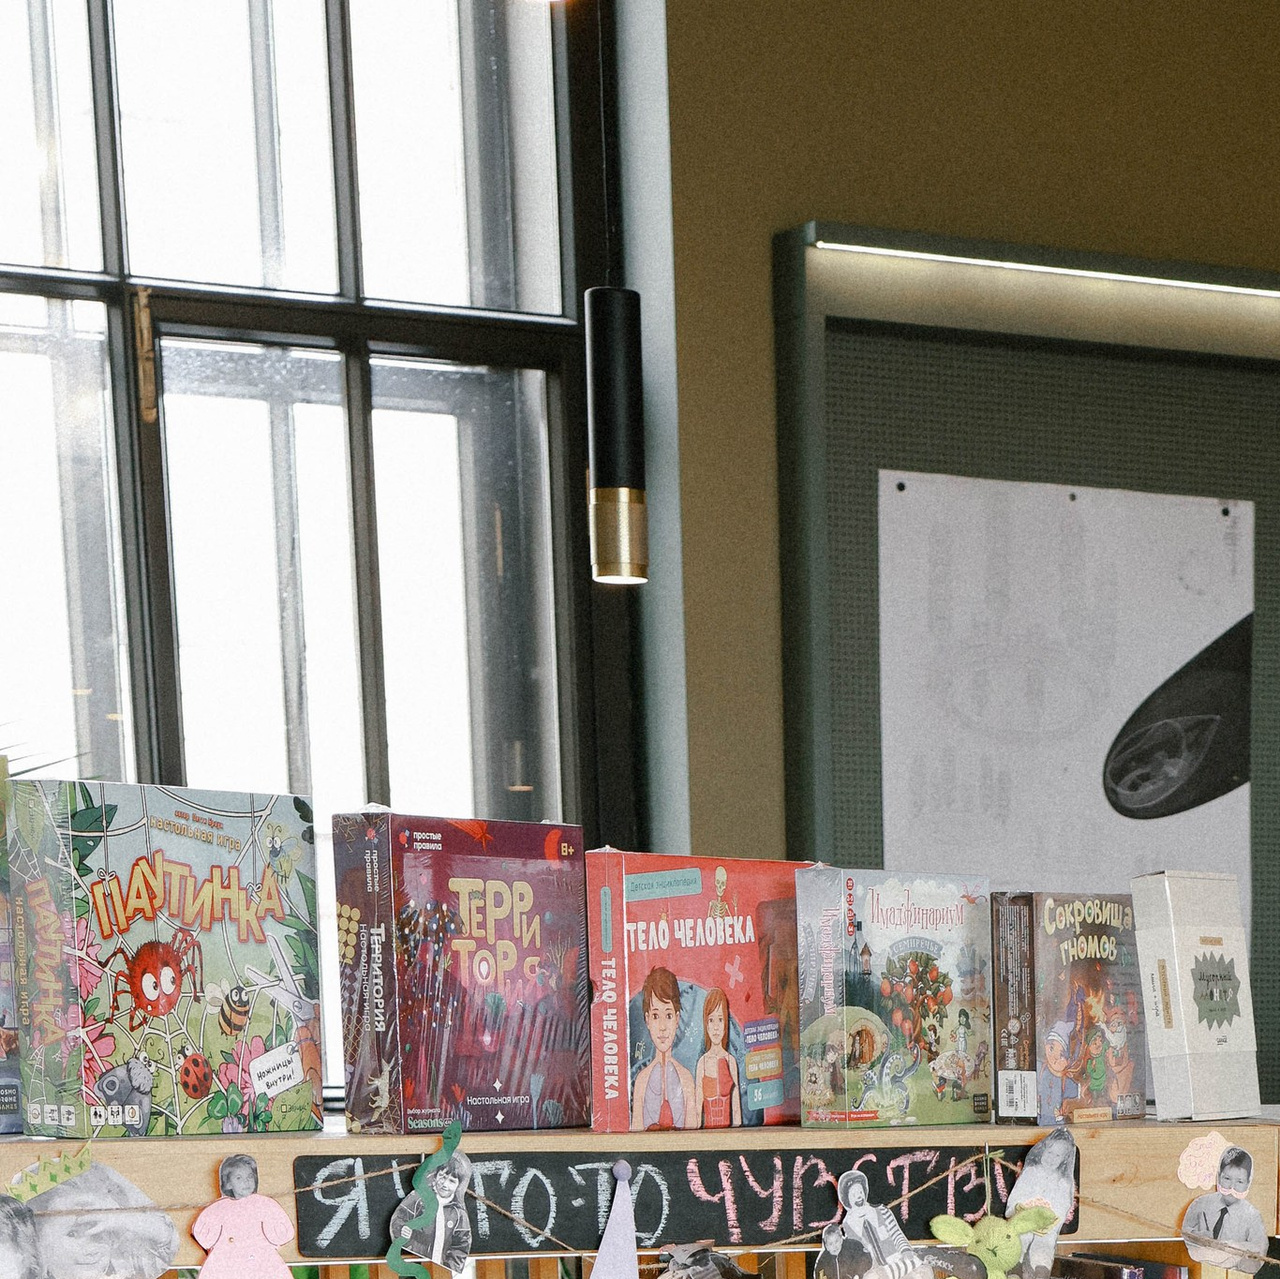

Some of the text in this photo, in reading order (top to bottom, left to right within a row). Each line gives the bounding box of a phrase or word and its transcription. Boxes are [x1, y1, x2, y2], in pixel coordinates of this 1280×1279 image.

[150, 815, 214, 843] настольная
[216, 831, 242, 852] игра
[413, 831, 442, 842] простые
[413, 841, 442, 851] правила
[561, 843, 575, 856] 8+
[91, 848, 285, 943] ПАУТИНКА
[626, 918, 670, 952] ТЕЛО
[673, 914, 756, 948] ЧЕЛОВЕКА
[1043, 897, 1133, 935] Сокровища
[25, 878, 67, 1046] ПАУТИНКА
[370, 923, 386, 1033] ТЕРРИТОРИЯ
[601, 957, 616, 1001] ТЕЛО
[256, 1056, 294, 1083] НОЖНИЦЫ
[602, 1004, 619, 1101] ЧЕЛОВЕКА
[466, 1095, 530, 1107] Настольная игра
[407, 1115, 444, 1129] Seasons
[316, 1157, 364, 1249] Я
